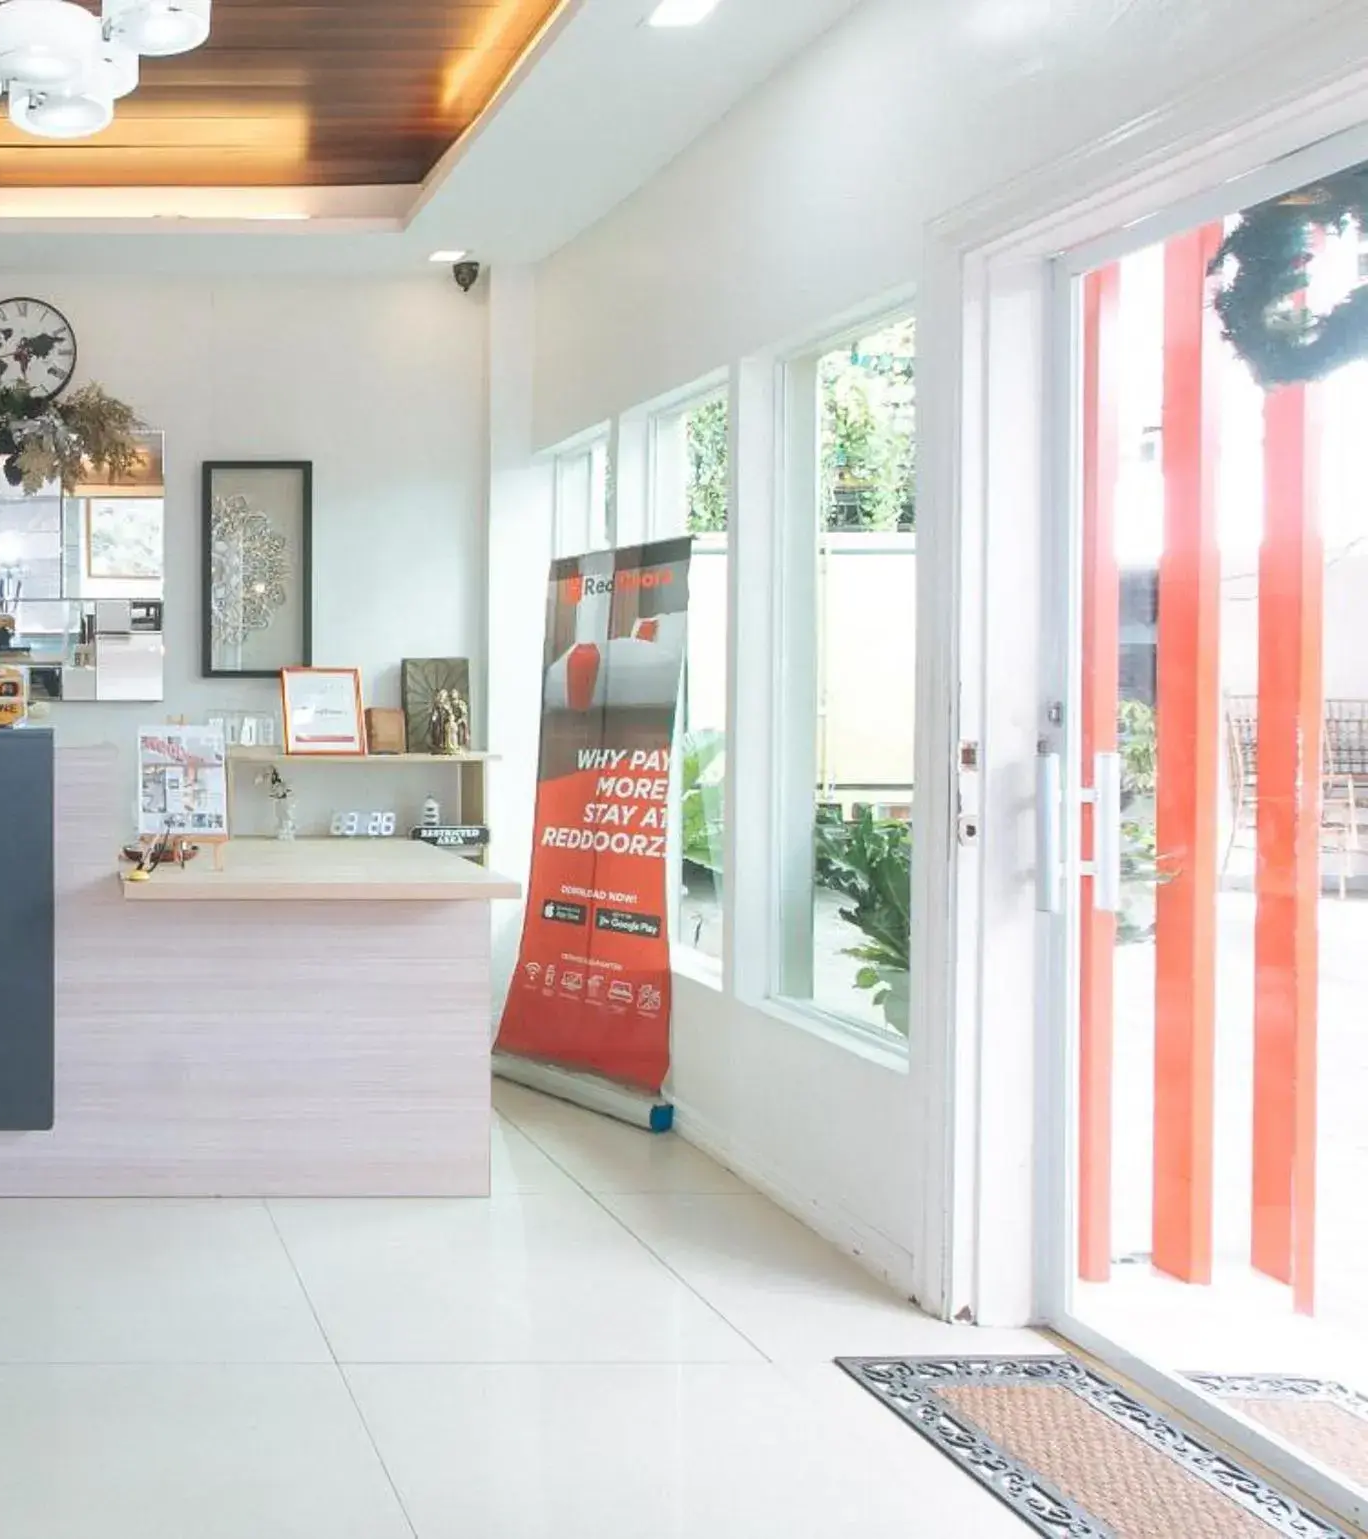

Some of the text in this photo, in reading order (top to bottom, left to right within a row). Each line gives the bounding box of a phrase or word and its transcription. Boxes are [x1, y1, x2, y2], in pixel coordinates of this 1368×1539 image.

[577, 748, 671, 771] WHY PAY
[595, 776, 668, 800] MORE
[583, 803, 638, 825] STAY
[560, 885, 607, 899] DOWNLOAD
